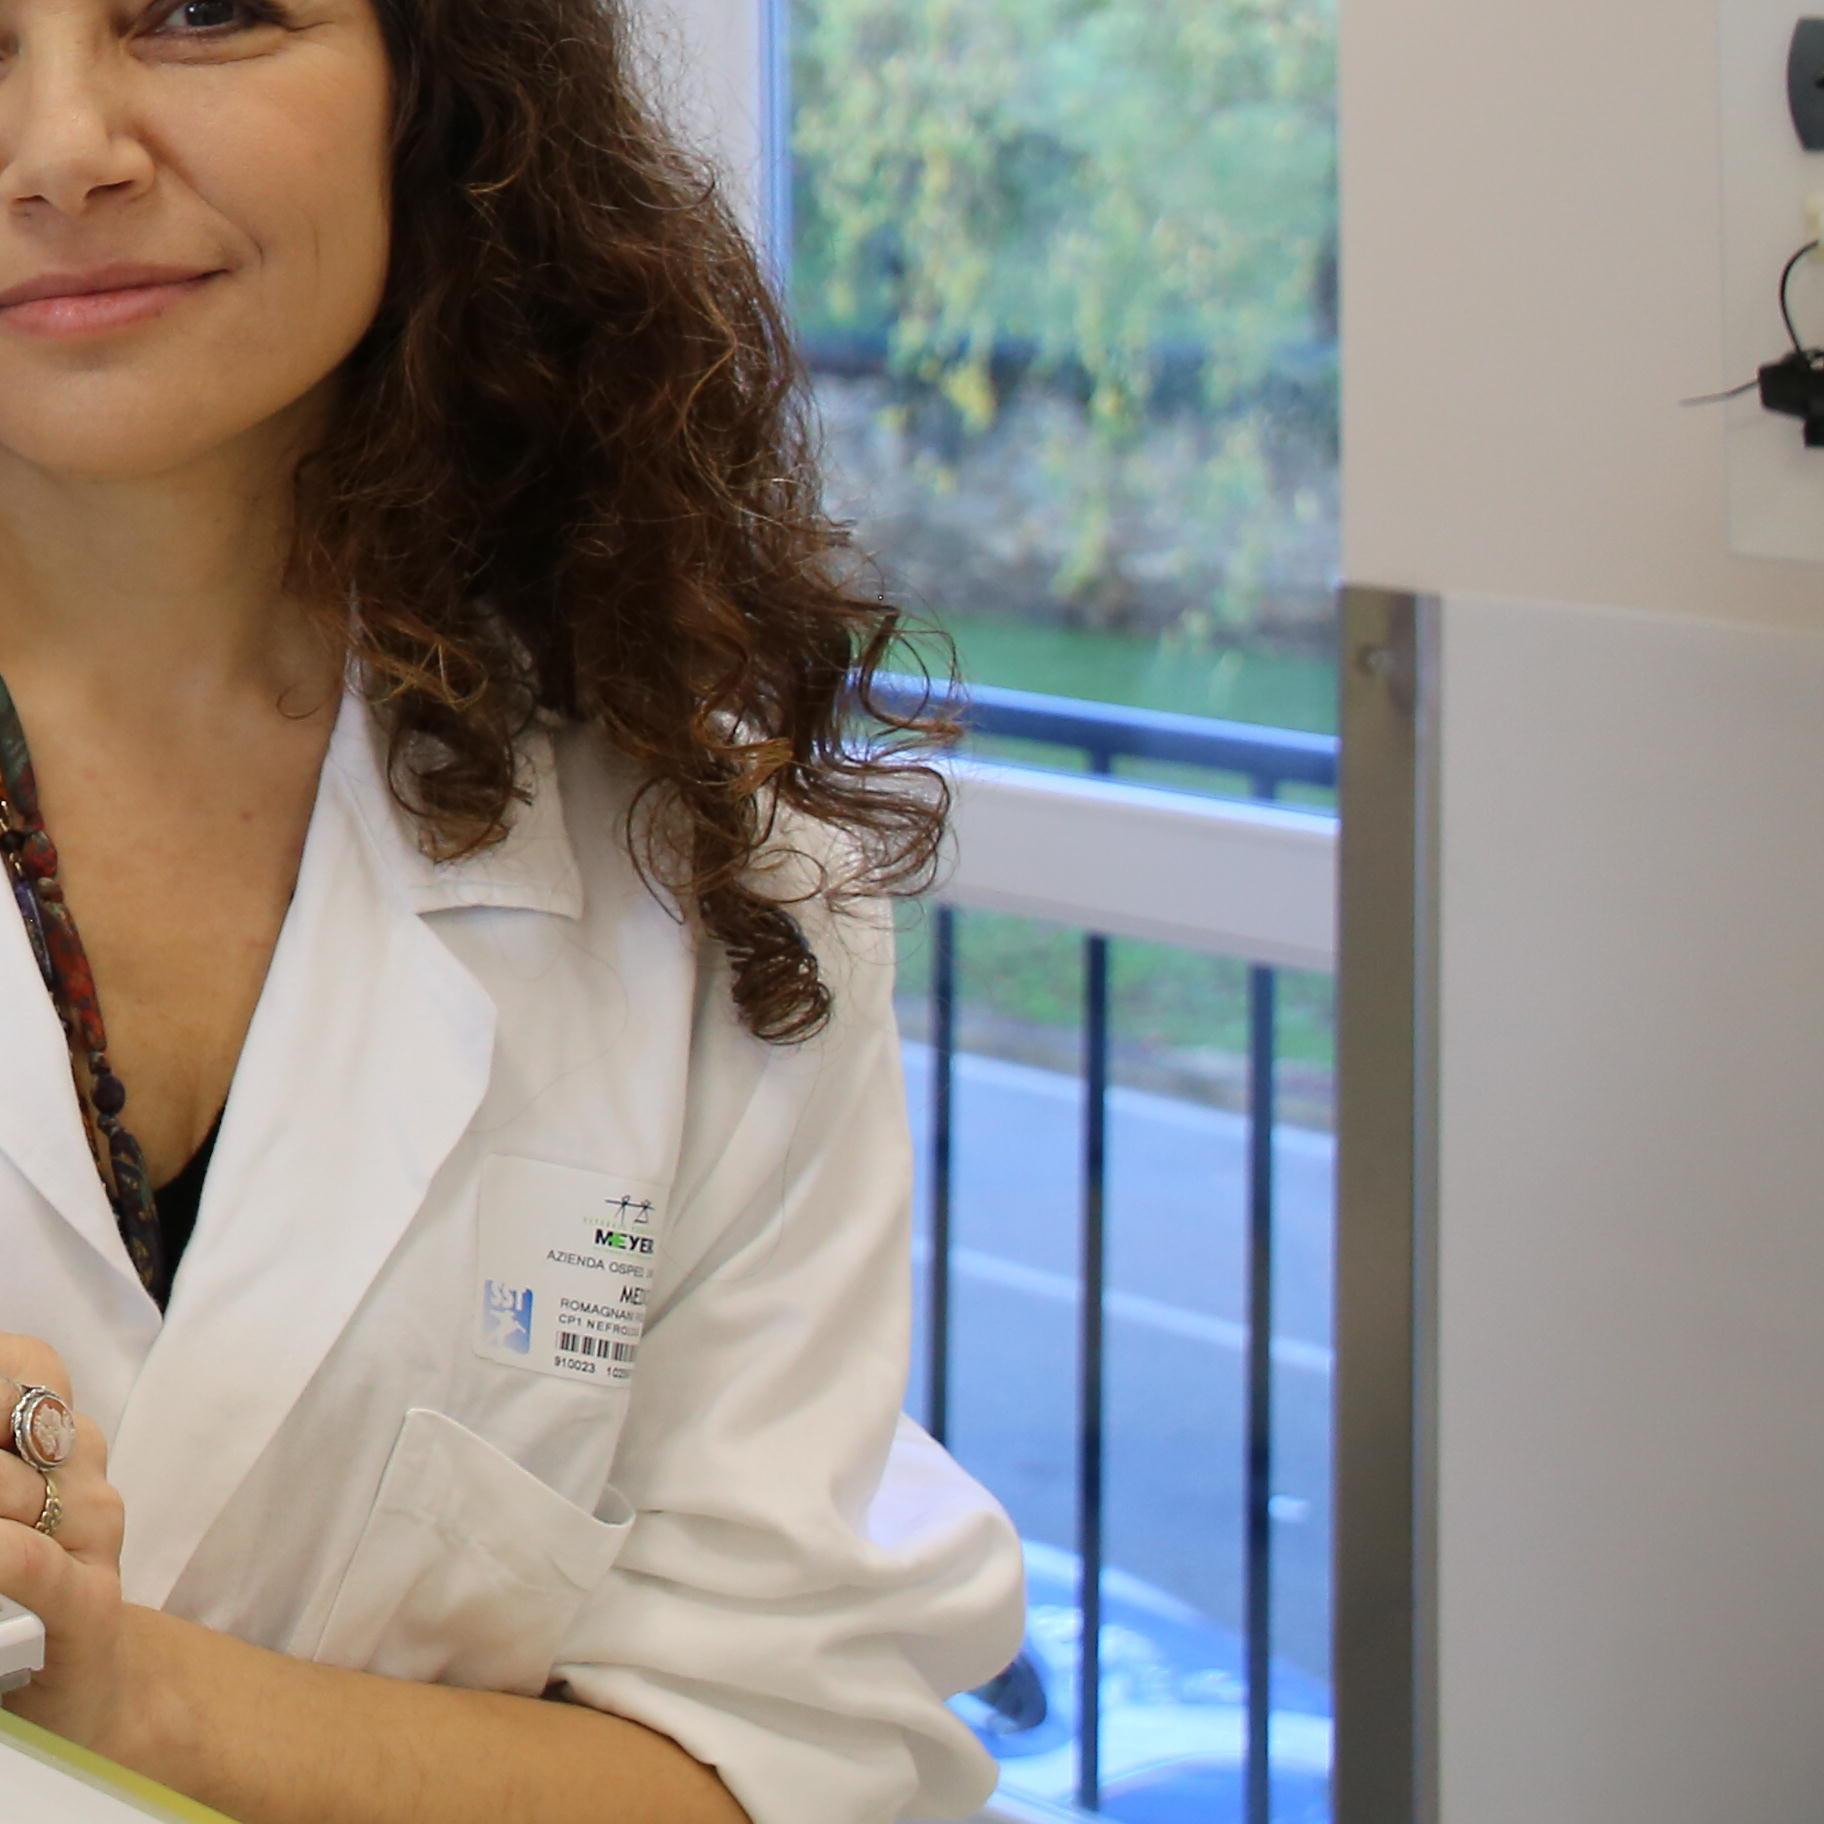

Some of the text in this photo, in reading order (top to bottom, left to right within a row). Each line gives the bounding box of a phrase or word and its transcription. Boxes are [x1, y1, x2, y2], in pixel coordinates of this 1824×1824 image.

[546, 1249, 605, 1271] AZIENDA
[558, 1313, 582, 1327] CP1
[553, 1355, 596, 1374] 910023
